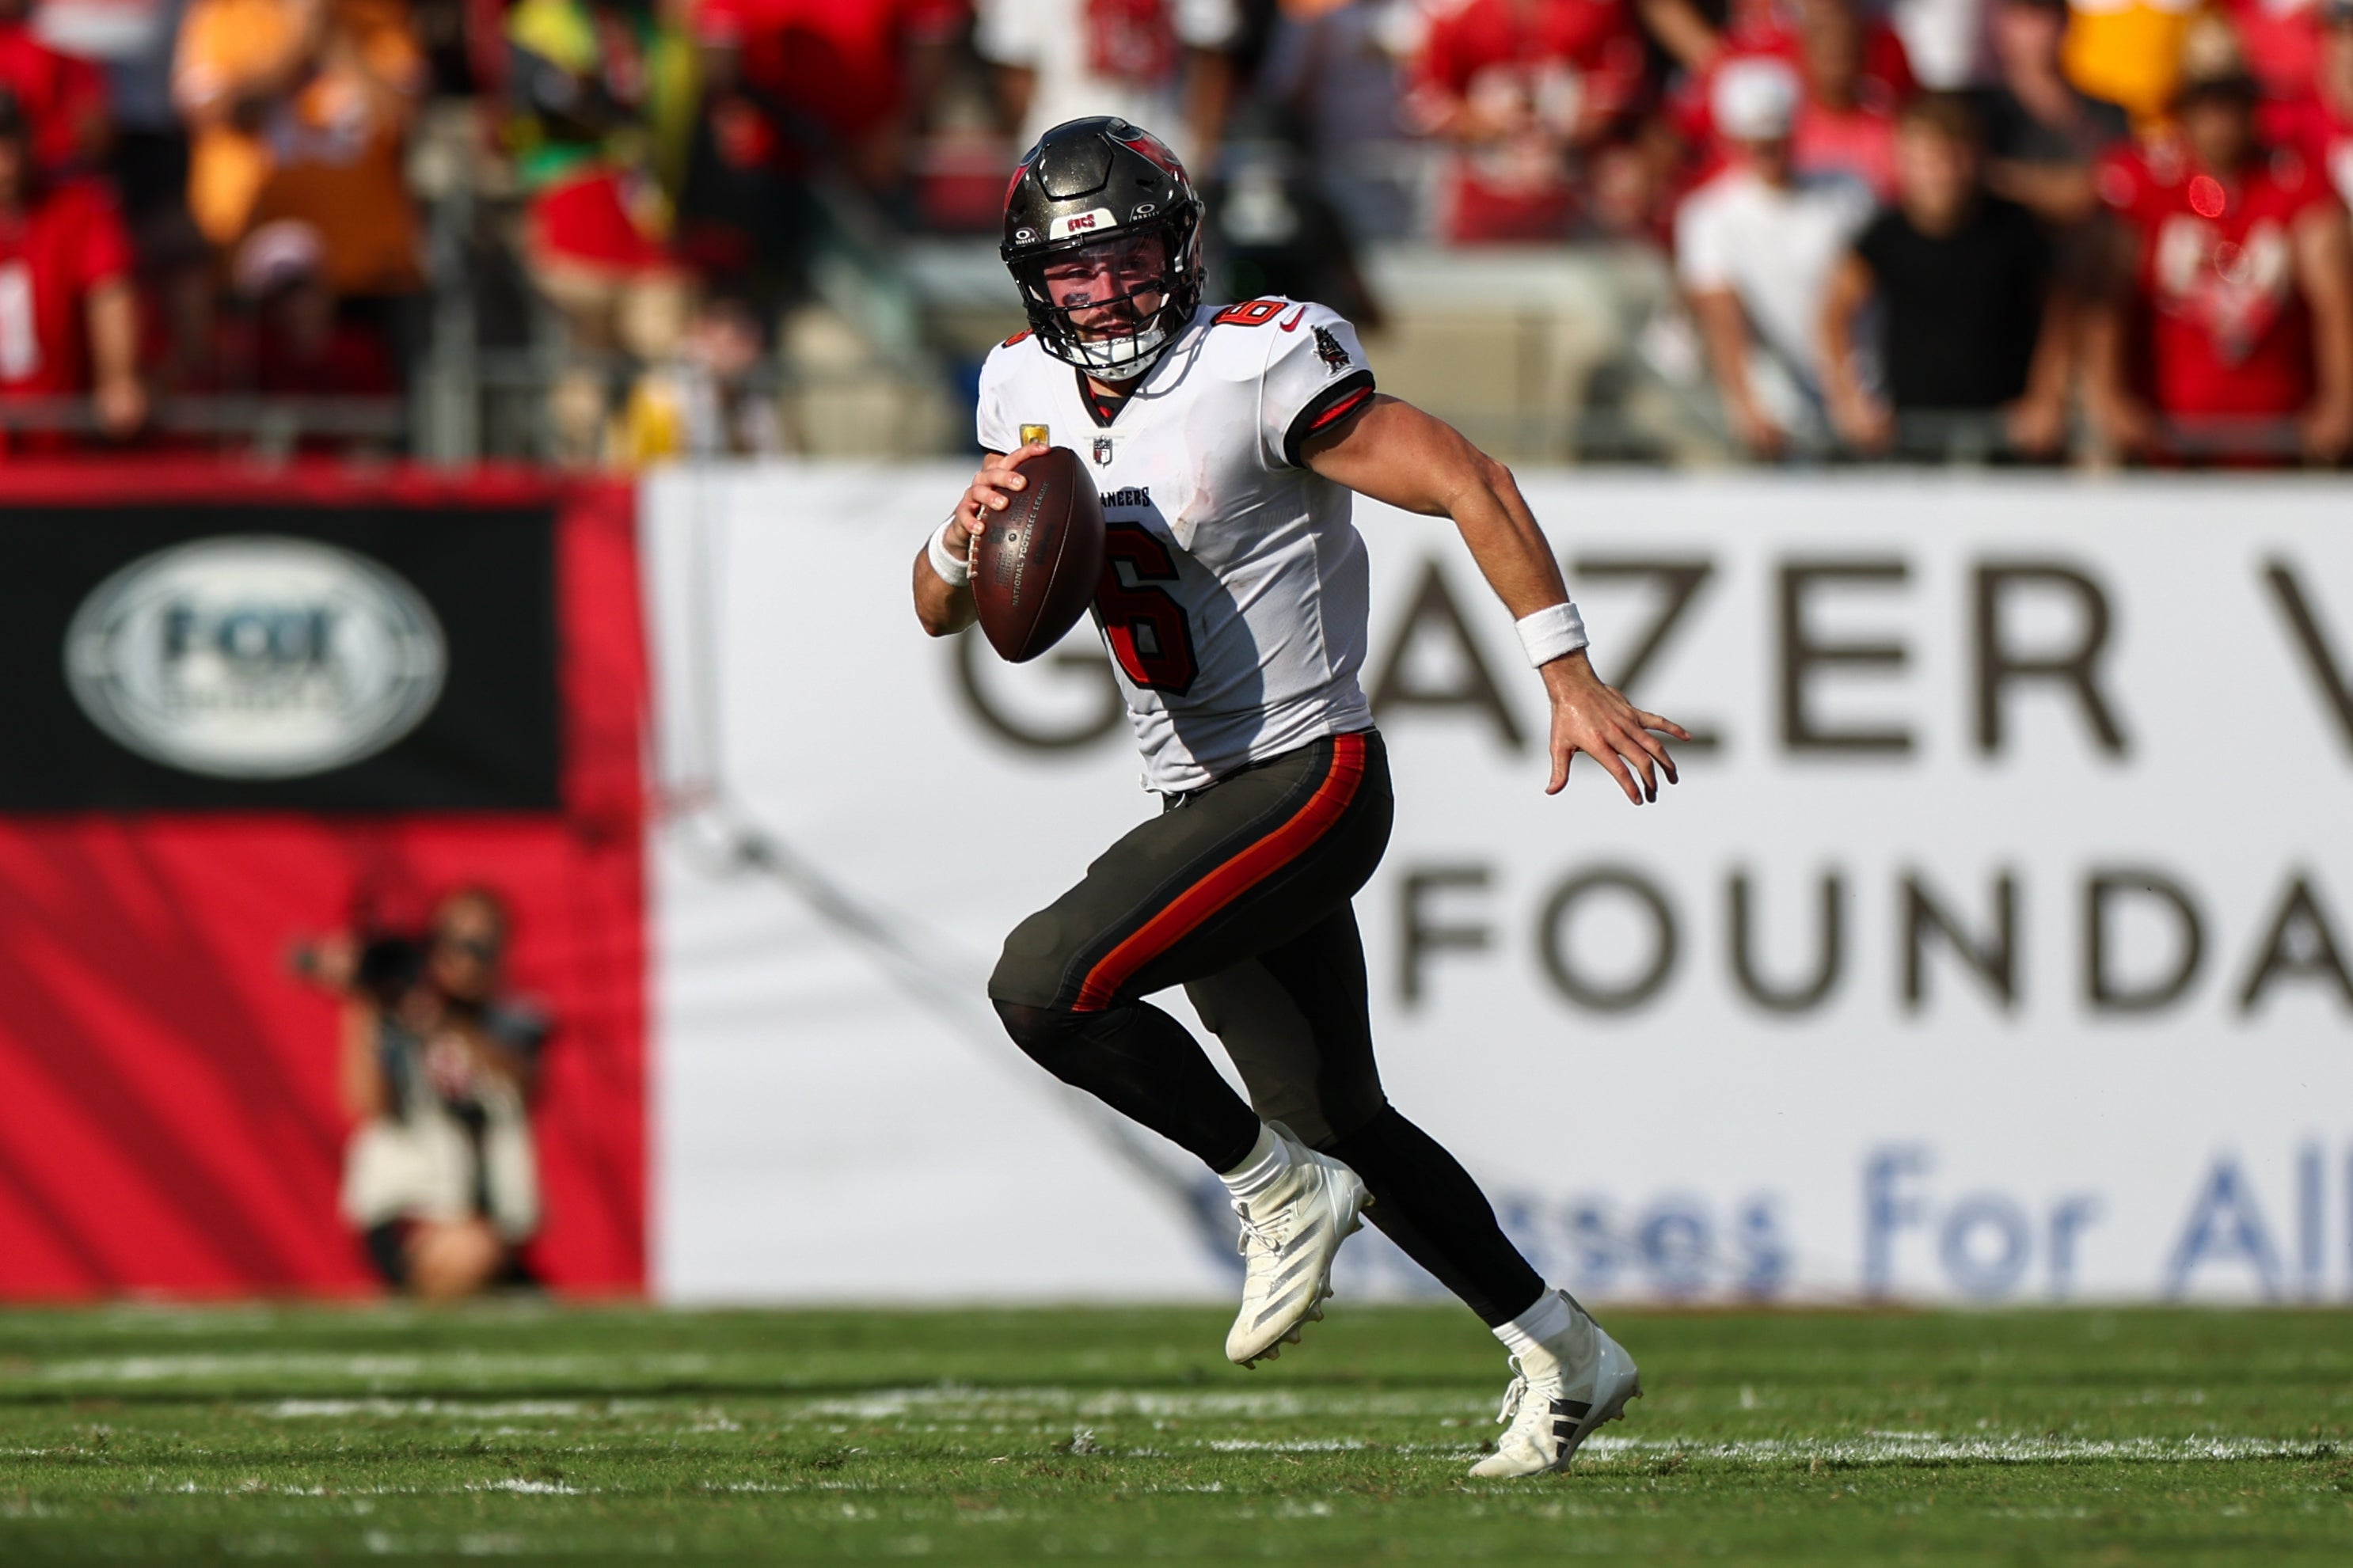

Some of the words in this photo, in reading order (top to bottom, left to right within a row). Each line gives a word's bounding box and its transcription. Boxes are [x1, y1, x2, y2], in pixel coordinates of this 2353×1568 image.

[1211, 300, 1288, 326] 6
[1012, 562, 1024, 607] NATIONAL
[1020, 513, 1037, 560] FOOTBALL
[1099, 486, 1150, 508] ANEERS
[952, 552, 2131, 758] GAZER
[1095, 522, 1199, 697] 6
[1862, 1141, 2104, 1303] For
